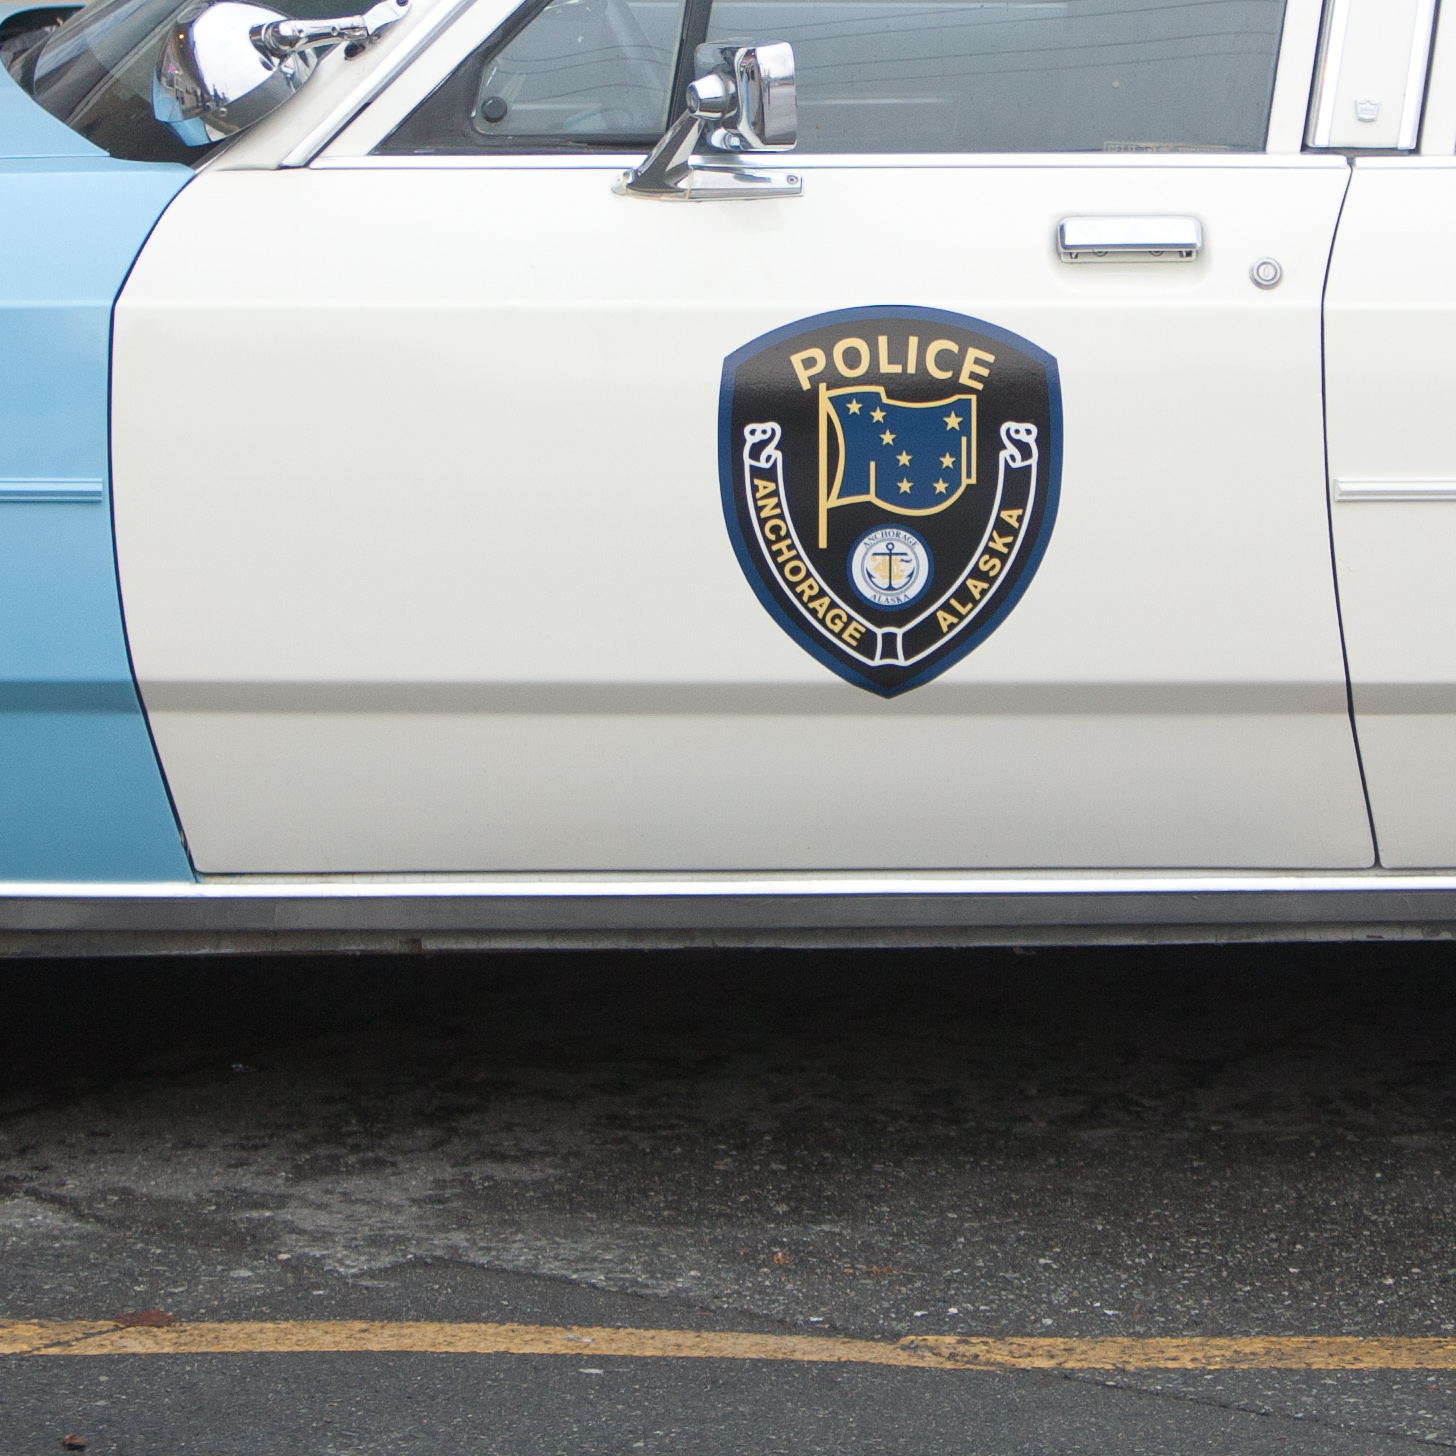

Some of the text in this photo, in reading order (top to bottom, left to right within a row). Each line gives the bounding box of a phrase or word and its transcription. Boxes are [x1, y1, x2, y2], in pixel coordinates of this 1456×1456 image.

[790, 335, 995, 391] POLICE
[753, 477, 866, 647] ANCHORAGE
[863, 530, 919, 549] ANCHORAGE
[935, 508, 1023, 632] ALASKA
[870, 594, 910, 605] ALASKA
